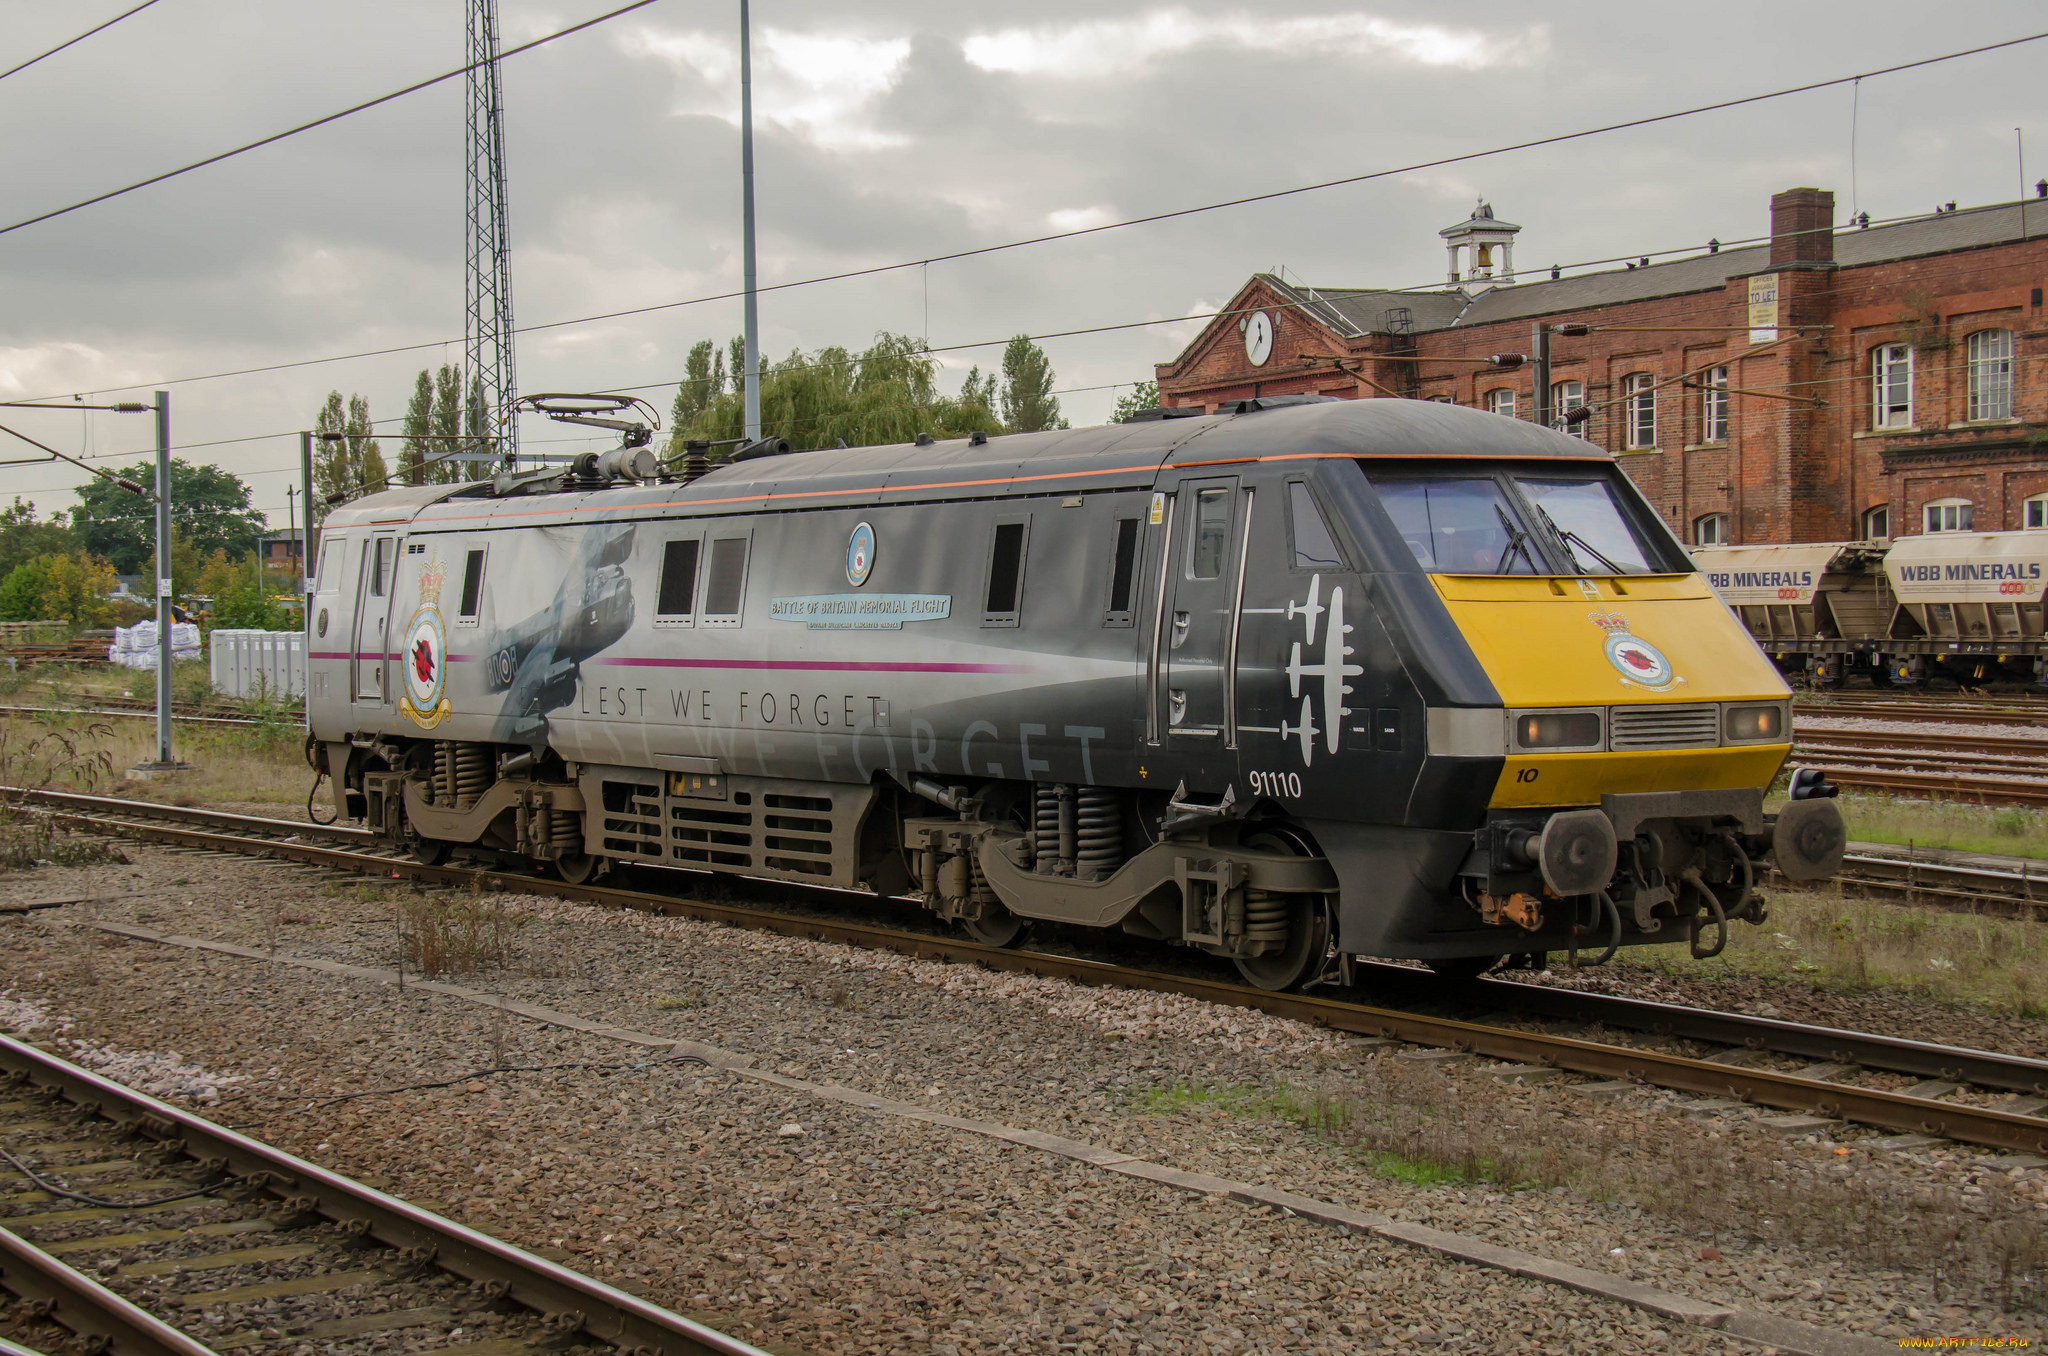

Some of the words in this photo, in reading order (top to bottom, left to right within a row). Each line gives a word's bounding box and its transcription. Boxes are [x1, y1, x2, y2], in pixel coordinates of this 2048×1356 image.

[1751, 292, 1760, 303] TO
[1763, 290, 1776, 302] LET
[1708, 573, 1730, 587] BB
[1733, 571, 1811, 587] MINERALS
[1900, 566, 1940, 581] WBB
[1945, 563, 2040, 580] MINERALS
[2000, 582, 2023, 595] WBB
[771, 601, 804, 615] BATTLE
[807, 601, 819, 614] OF
[821, 600, 856, 615] BRITAIN
[859, 600, 907, 614] MEMORIAL
[910, 599, 947, 614] FLIGHT
[581, 686, 647, 717] LEST
[671, 689, 712, 720] WE
[740, 691, 881, 728] FORGET
[815, 709, 1106, 786] FORGET
[1516, 768, 1539, 783] 10
[1249, 770, 1302, 798] 91110
